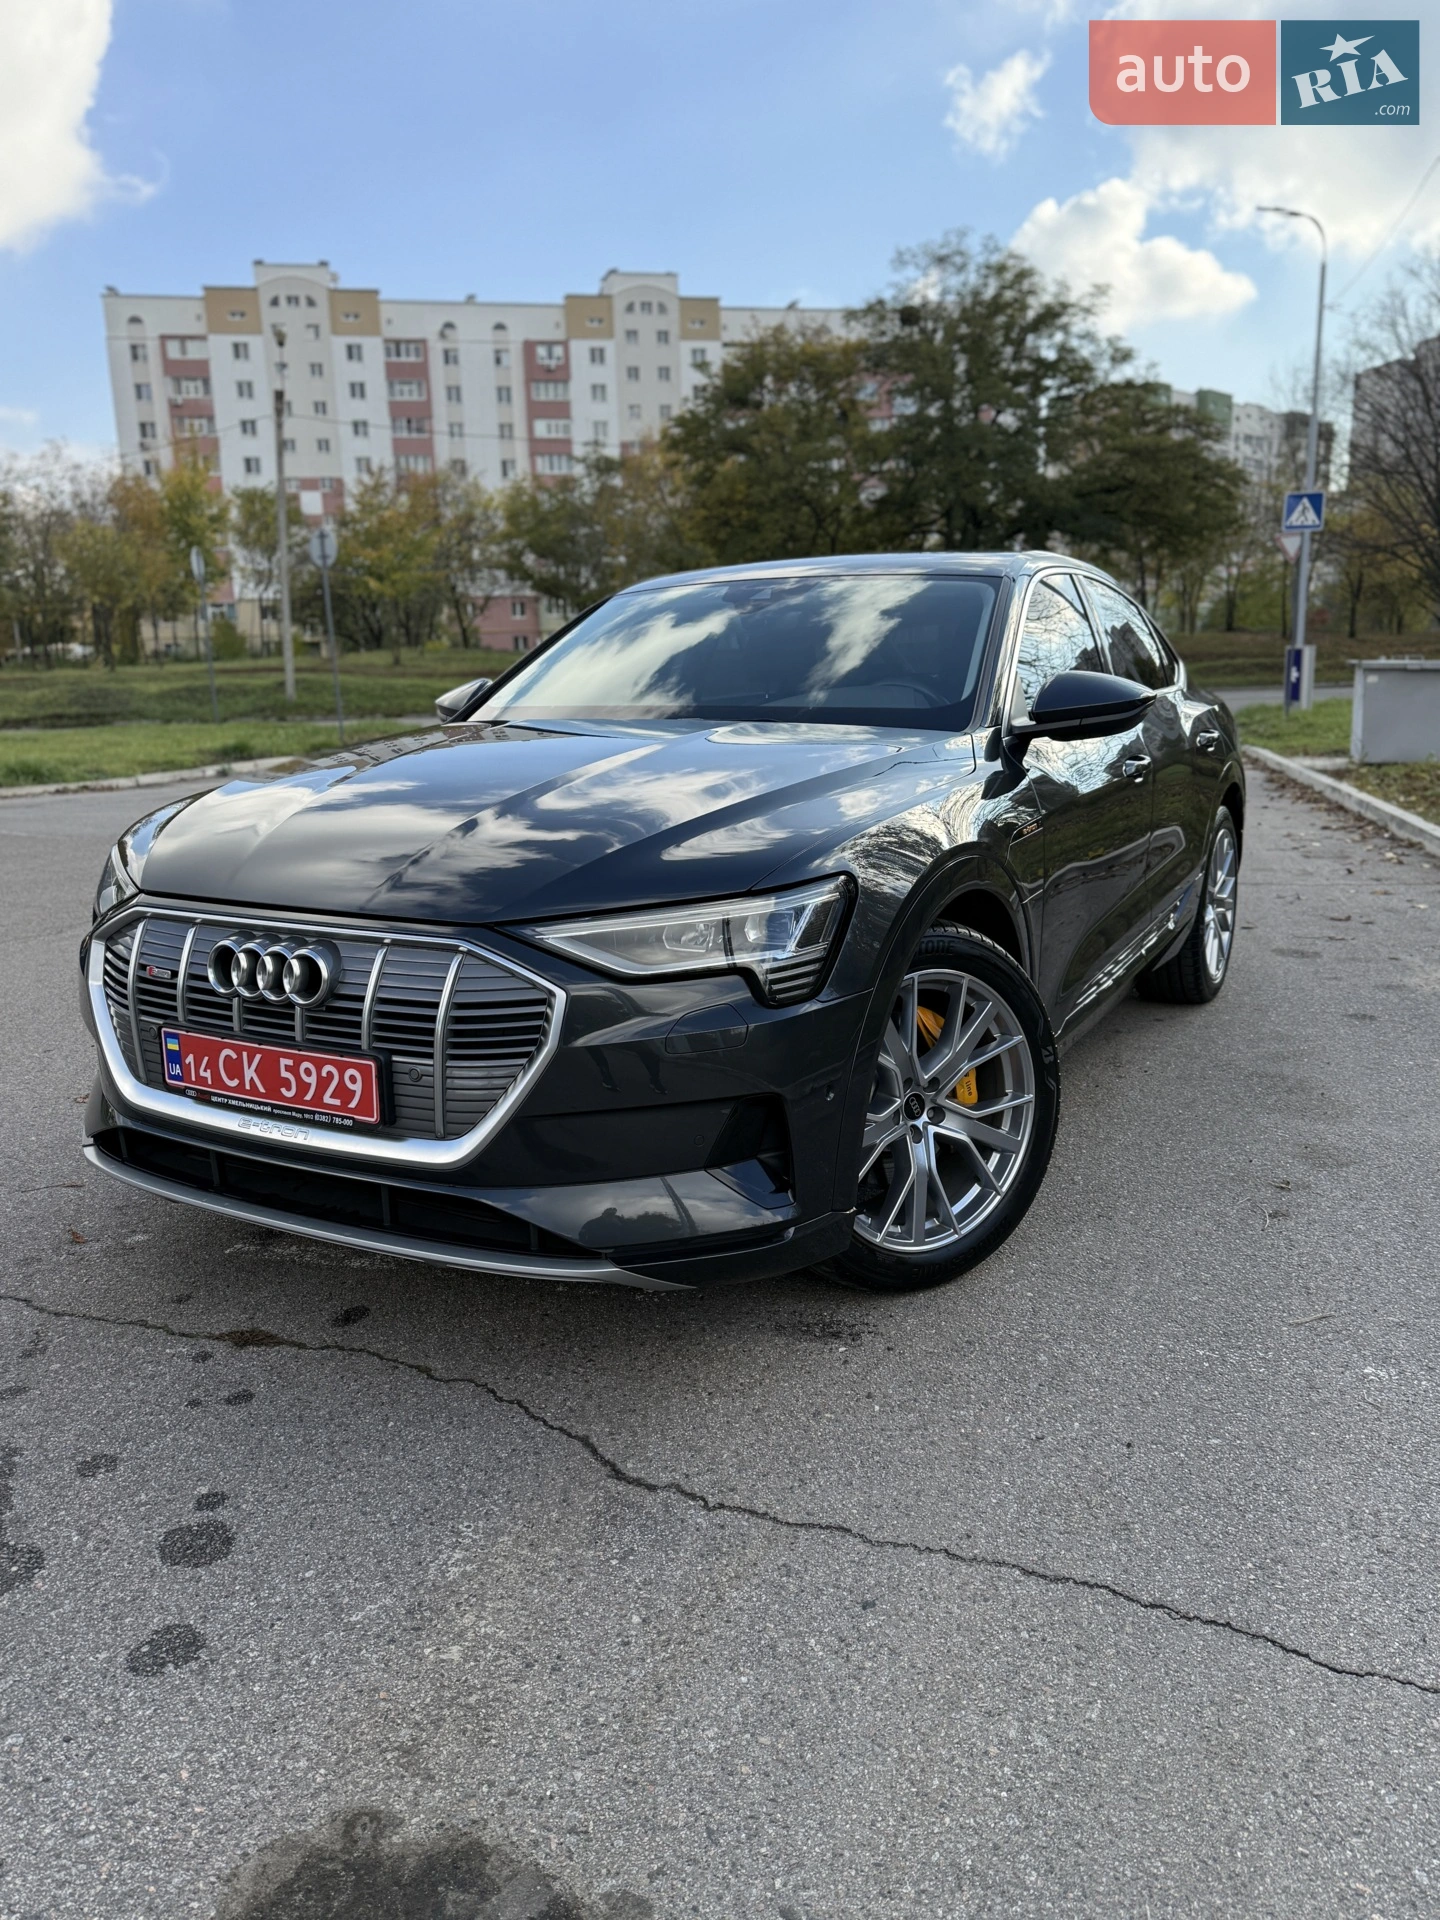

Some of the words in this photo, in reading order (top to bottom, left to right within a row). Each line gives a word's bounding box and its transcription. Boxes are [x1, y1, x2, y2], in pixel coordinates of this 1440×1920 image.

[169, 1063, 182, 1077] UA
[279, 1057, 363, 1109] 5929
[210, 1095, 228, 1104] ЦЕНТР
[228, 1100, 272, 1112] ХМЕЛЬНИЦЬКИЙ
[314, 1113, 332, 1123] (0382)
[332, 1116, 353, 1126] 785-000
[237, 1116, 310, 1140] e-tron
